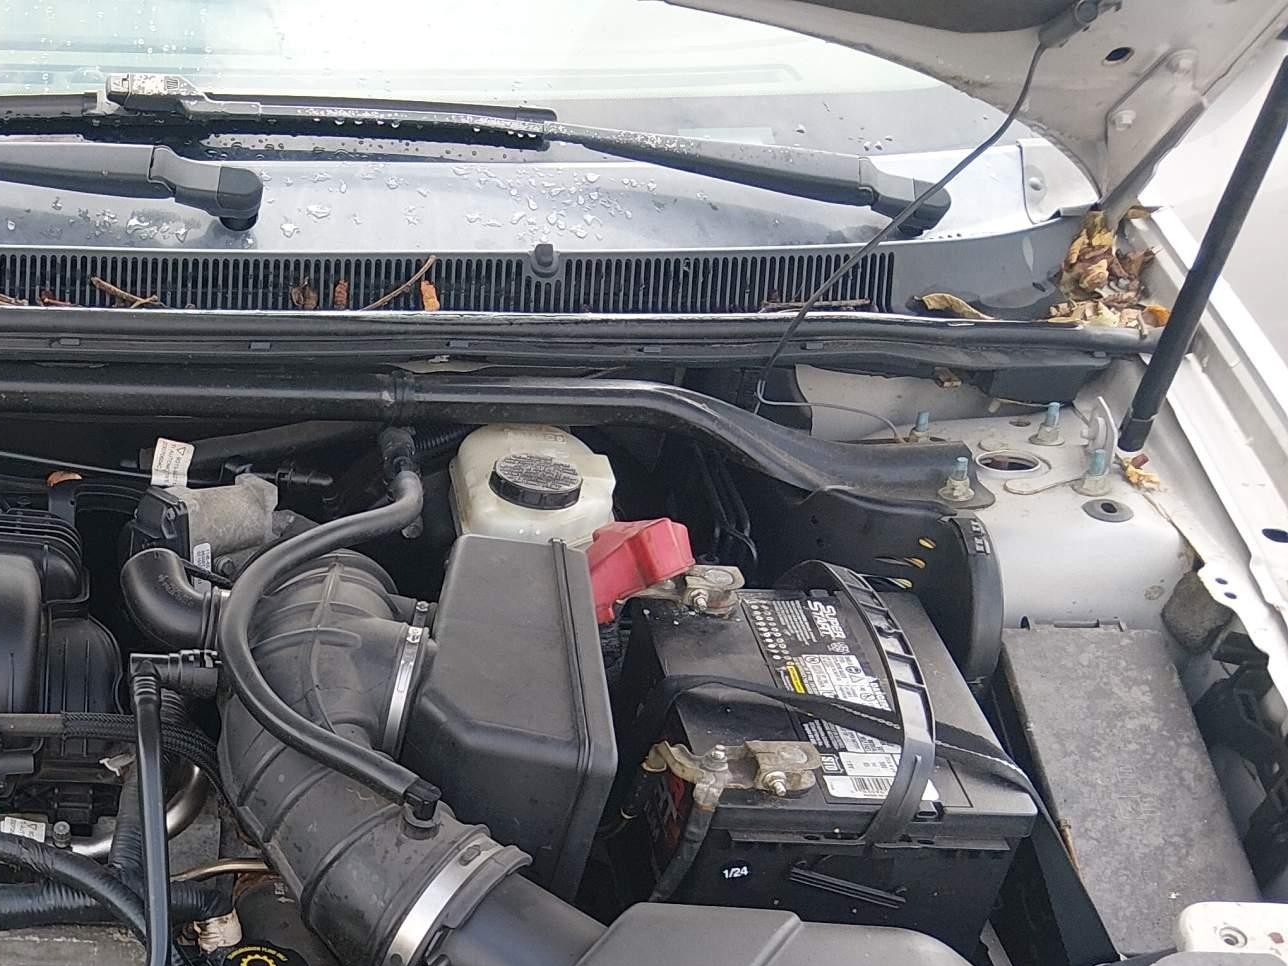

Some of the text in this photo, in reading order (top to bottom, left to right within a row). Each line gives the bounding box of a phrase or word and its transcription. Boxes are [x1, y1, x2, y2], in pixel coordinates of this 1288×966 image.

[807, 600, 835, 640] START
[822, 605, 846, 639] SUPER
[722, 866, 749, 879] 1/24
